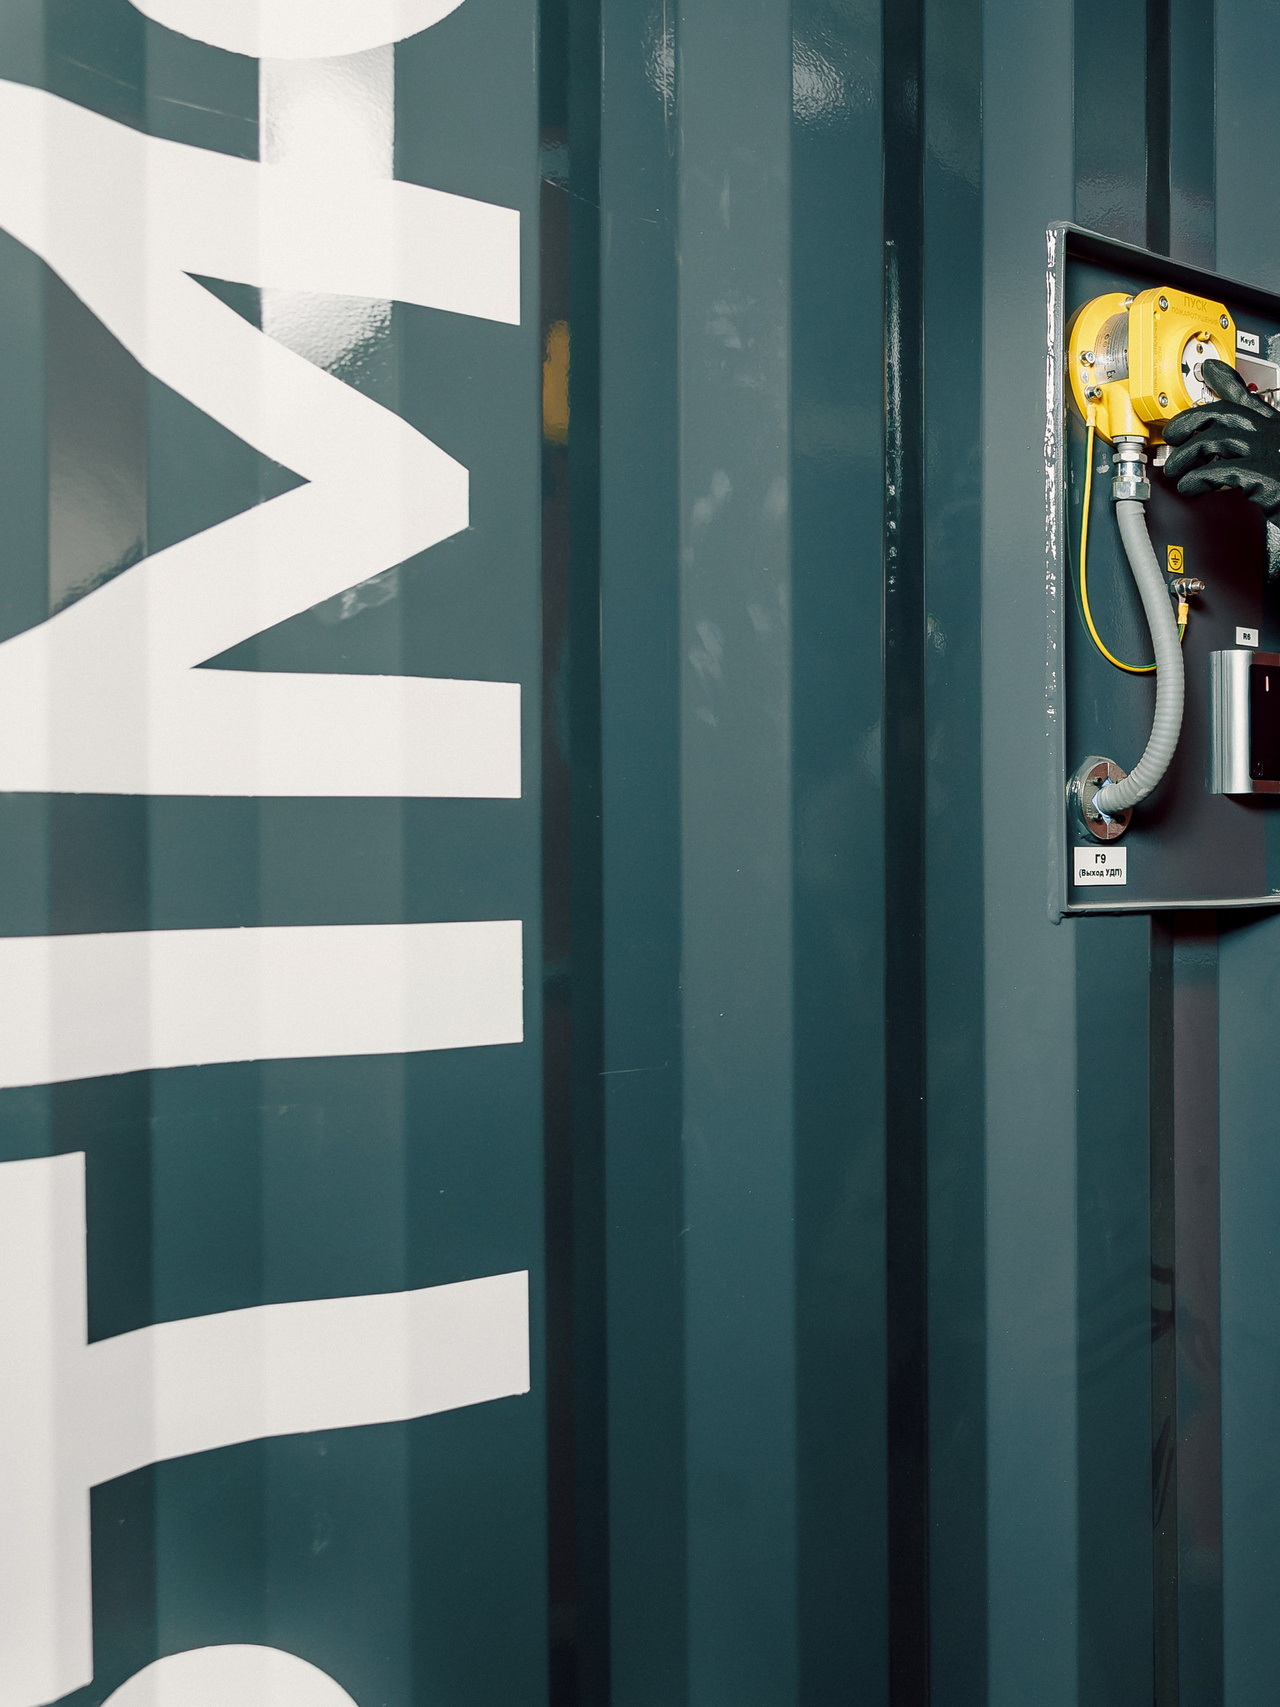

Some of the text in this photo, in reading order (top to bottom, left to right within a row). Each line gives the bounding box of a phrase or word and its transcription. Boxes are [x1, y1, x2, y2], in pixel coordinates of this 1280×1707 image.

[1184, 296, 1208, 312] ПУСК
[1095, 853, 1107, 864] Г9
[1079, 868, 1123, 878] (Выход УДП)
